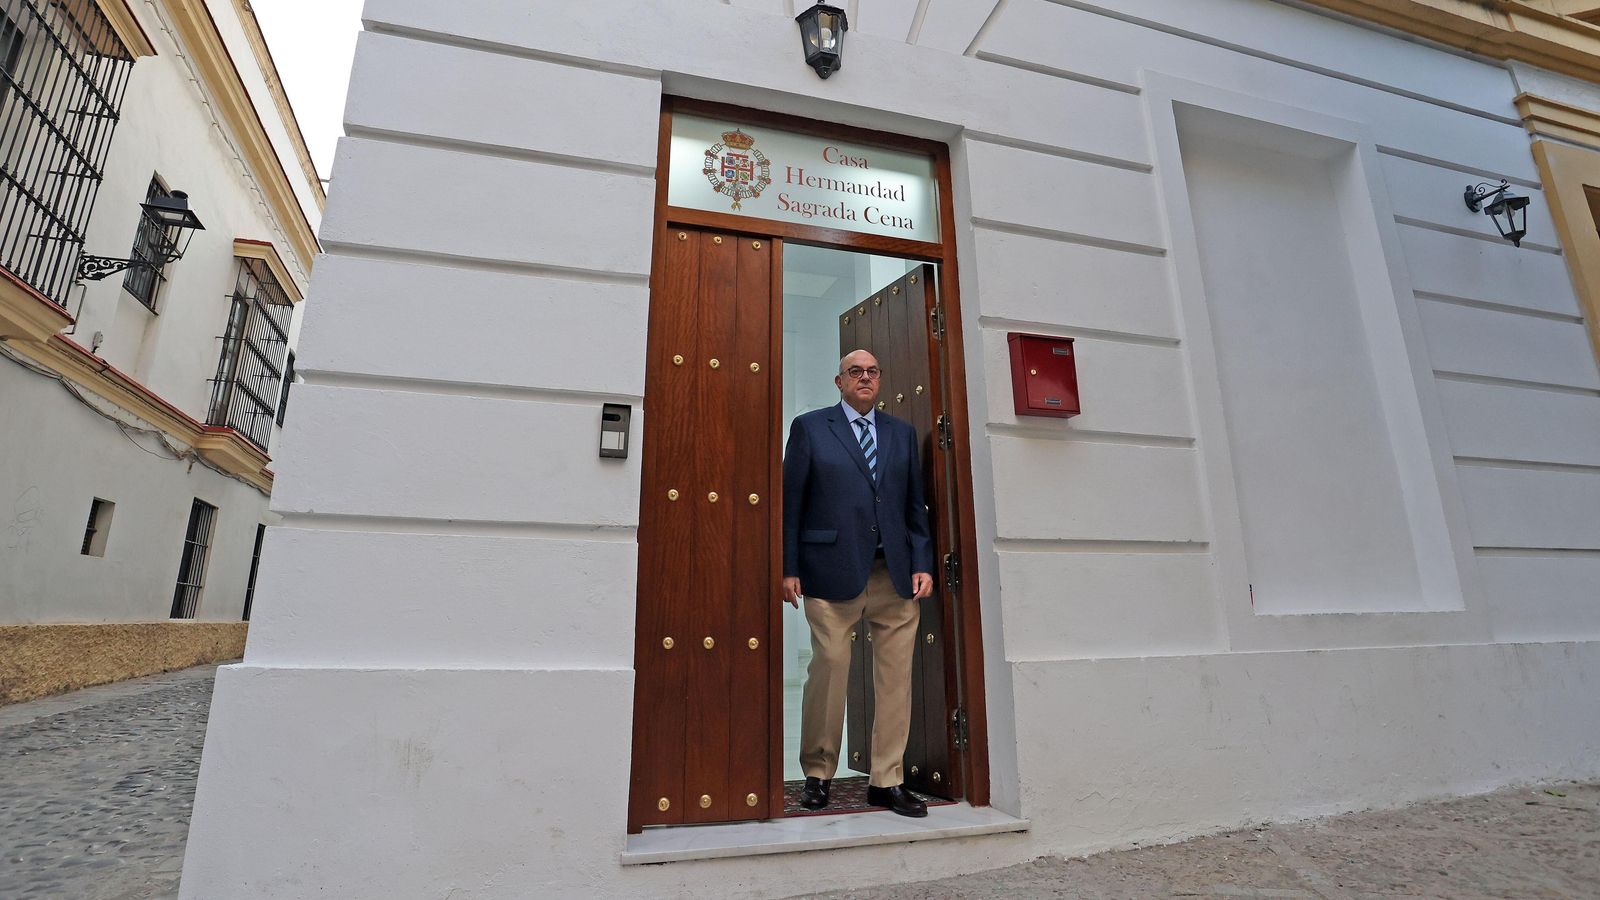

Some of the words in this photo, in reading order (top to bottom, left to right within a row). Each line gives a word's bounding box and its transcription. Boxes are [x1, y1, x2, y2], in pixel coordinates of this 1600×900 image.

[822, 146, 869, 169] Casa
[785, 166, 905, 202] Hermandad
[777, 193, 857, 221] Sagrada
[863, 206, 914, 230] Cena
